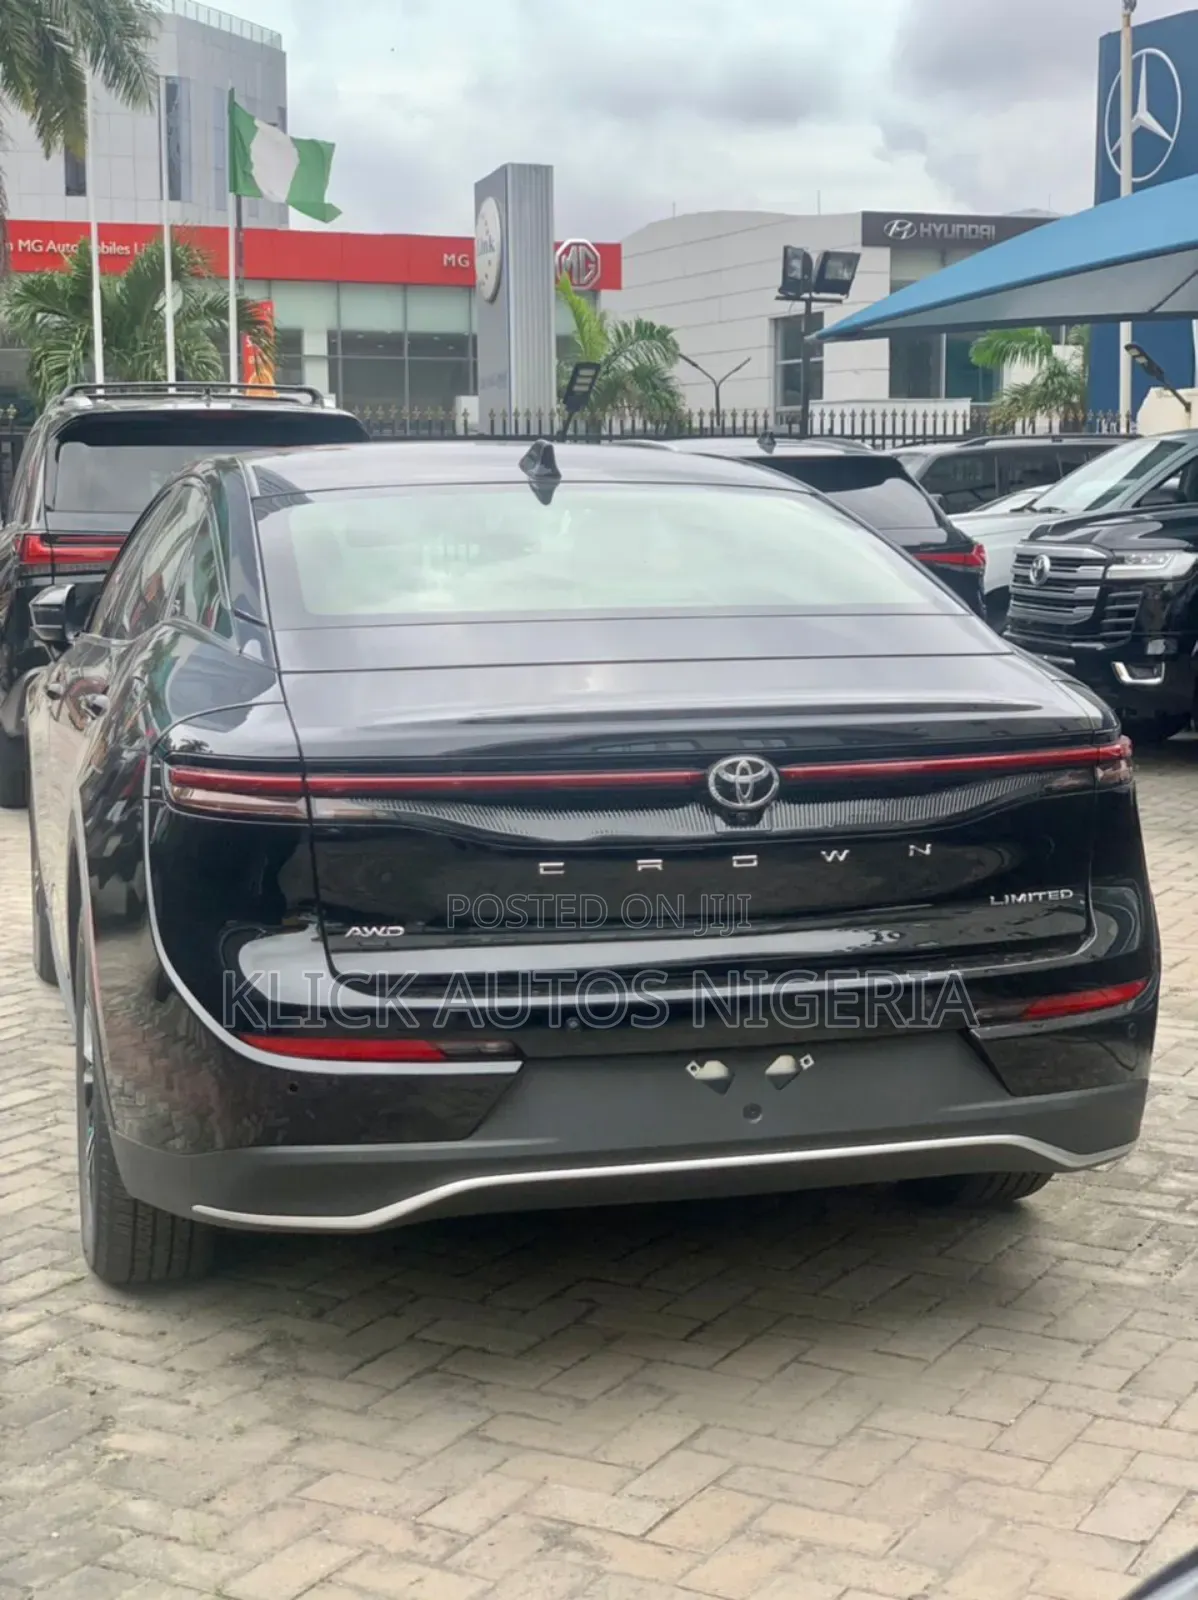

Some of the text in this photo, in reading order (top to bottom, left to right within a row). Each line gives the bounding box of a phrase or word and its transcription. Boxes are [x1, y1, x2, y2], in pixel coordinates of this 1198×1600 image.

[919, 222, 996, 240] HYUNDAI
[18, 239, 43, 253] MG
[46, 240, 131, 256] Autobiles
[443, 253, 470, 268] MG
[560, 244, 597, 286] MG
[538, 843, 932, 875] CROWN
[989, 889, 1074, 906] LIMITED
[344, 926, 405, 938] AWD
